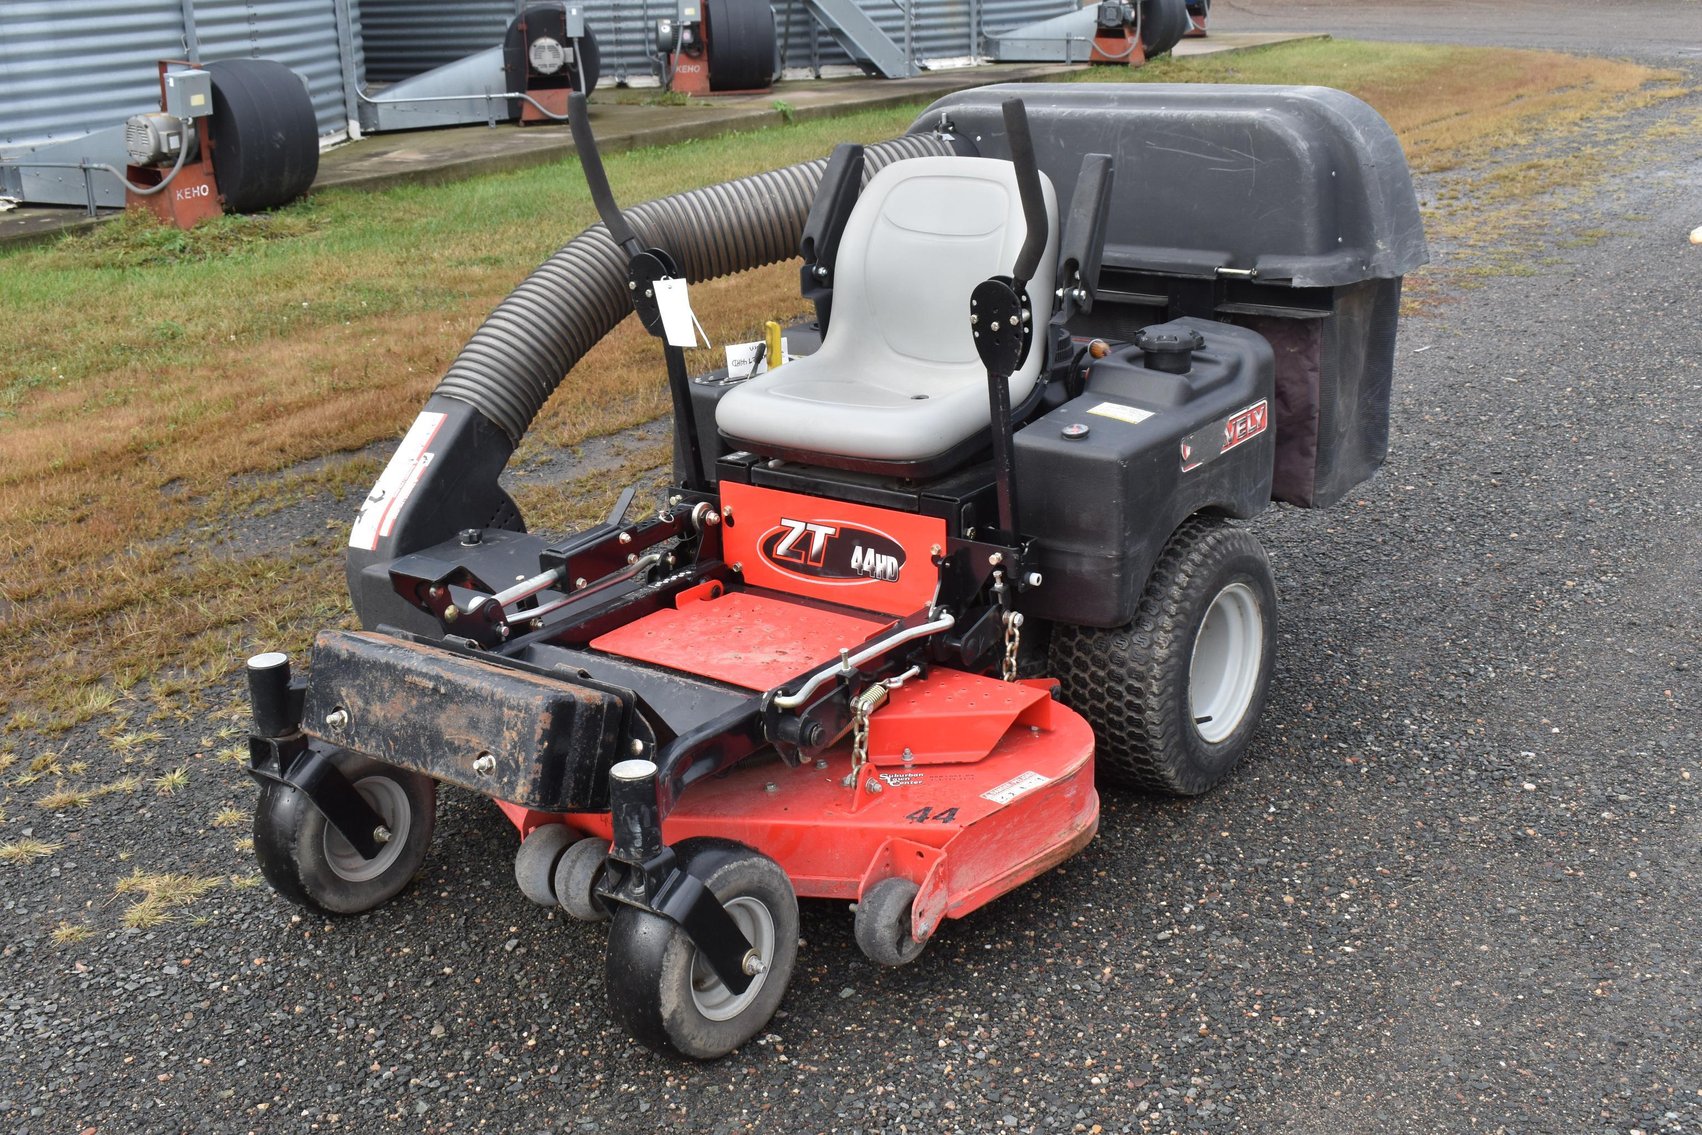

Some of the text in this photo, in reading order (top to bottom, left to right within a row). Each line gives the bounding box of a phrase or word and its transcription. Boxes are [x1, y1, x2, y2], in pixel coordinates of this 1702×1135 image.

[676, 64, 700, 73] KEHO
[176, 184, 209, 200] KEHO
[1223, 405, 1266, 447] VELY
[774, 518, 899, 582] ZT 44HD
[905, 806, 960, 824] 44
